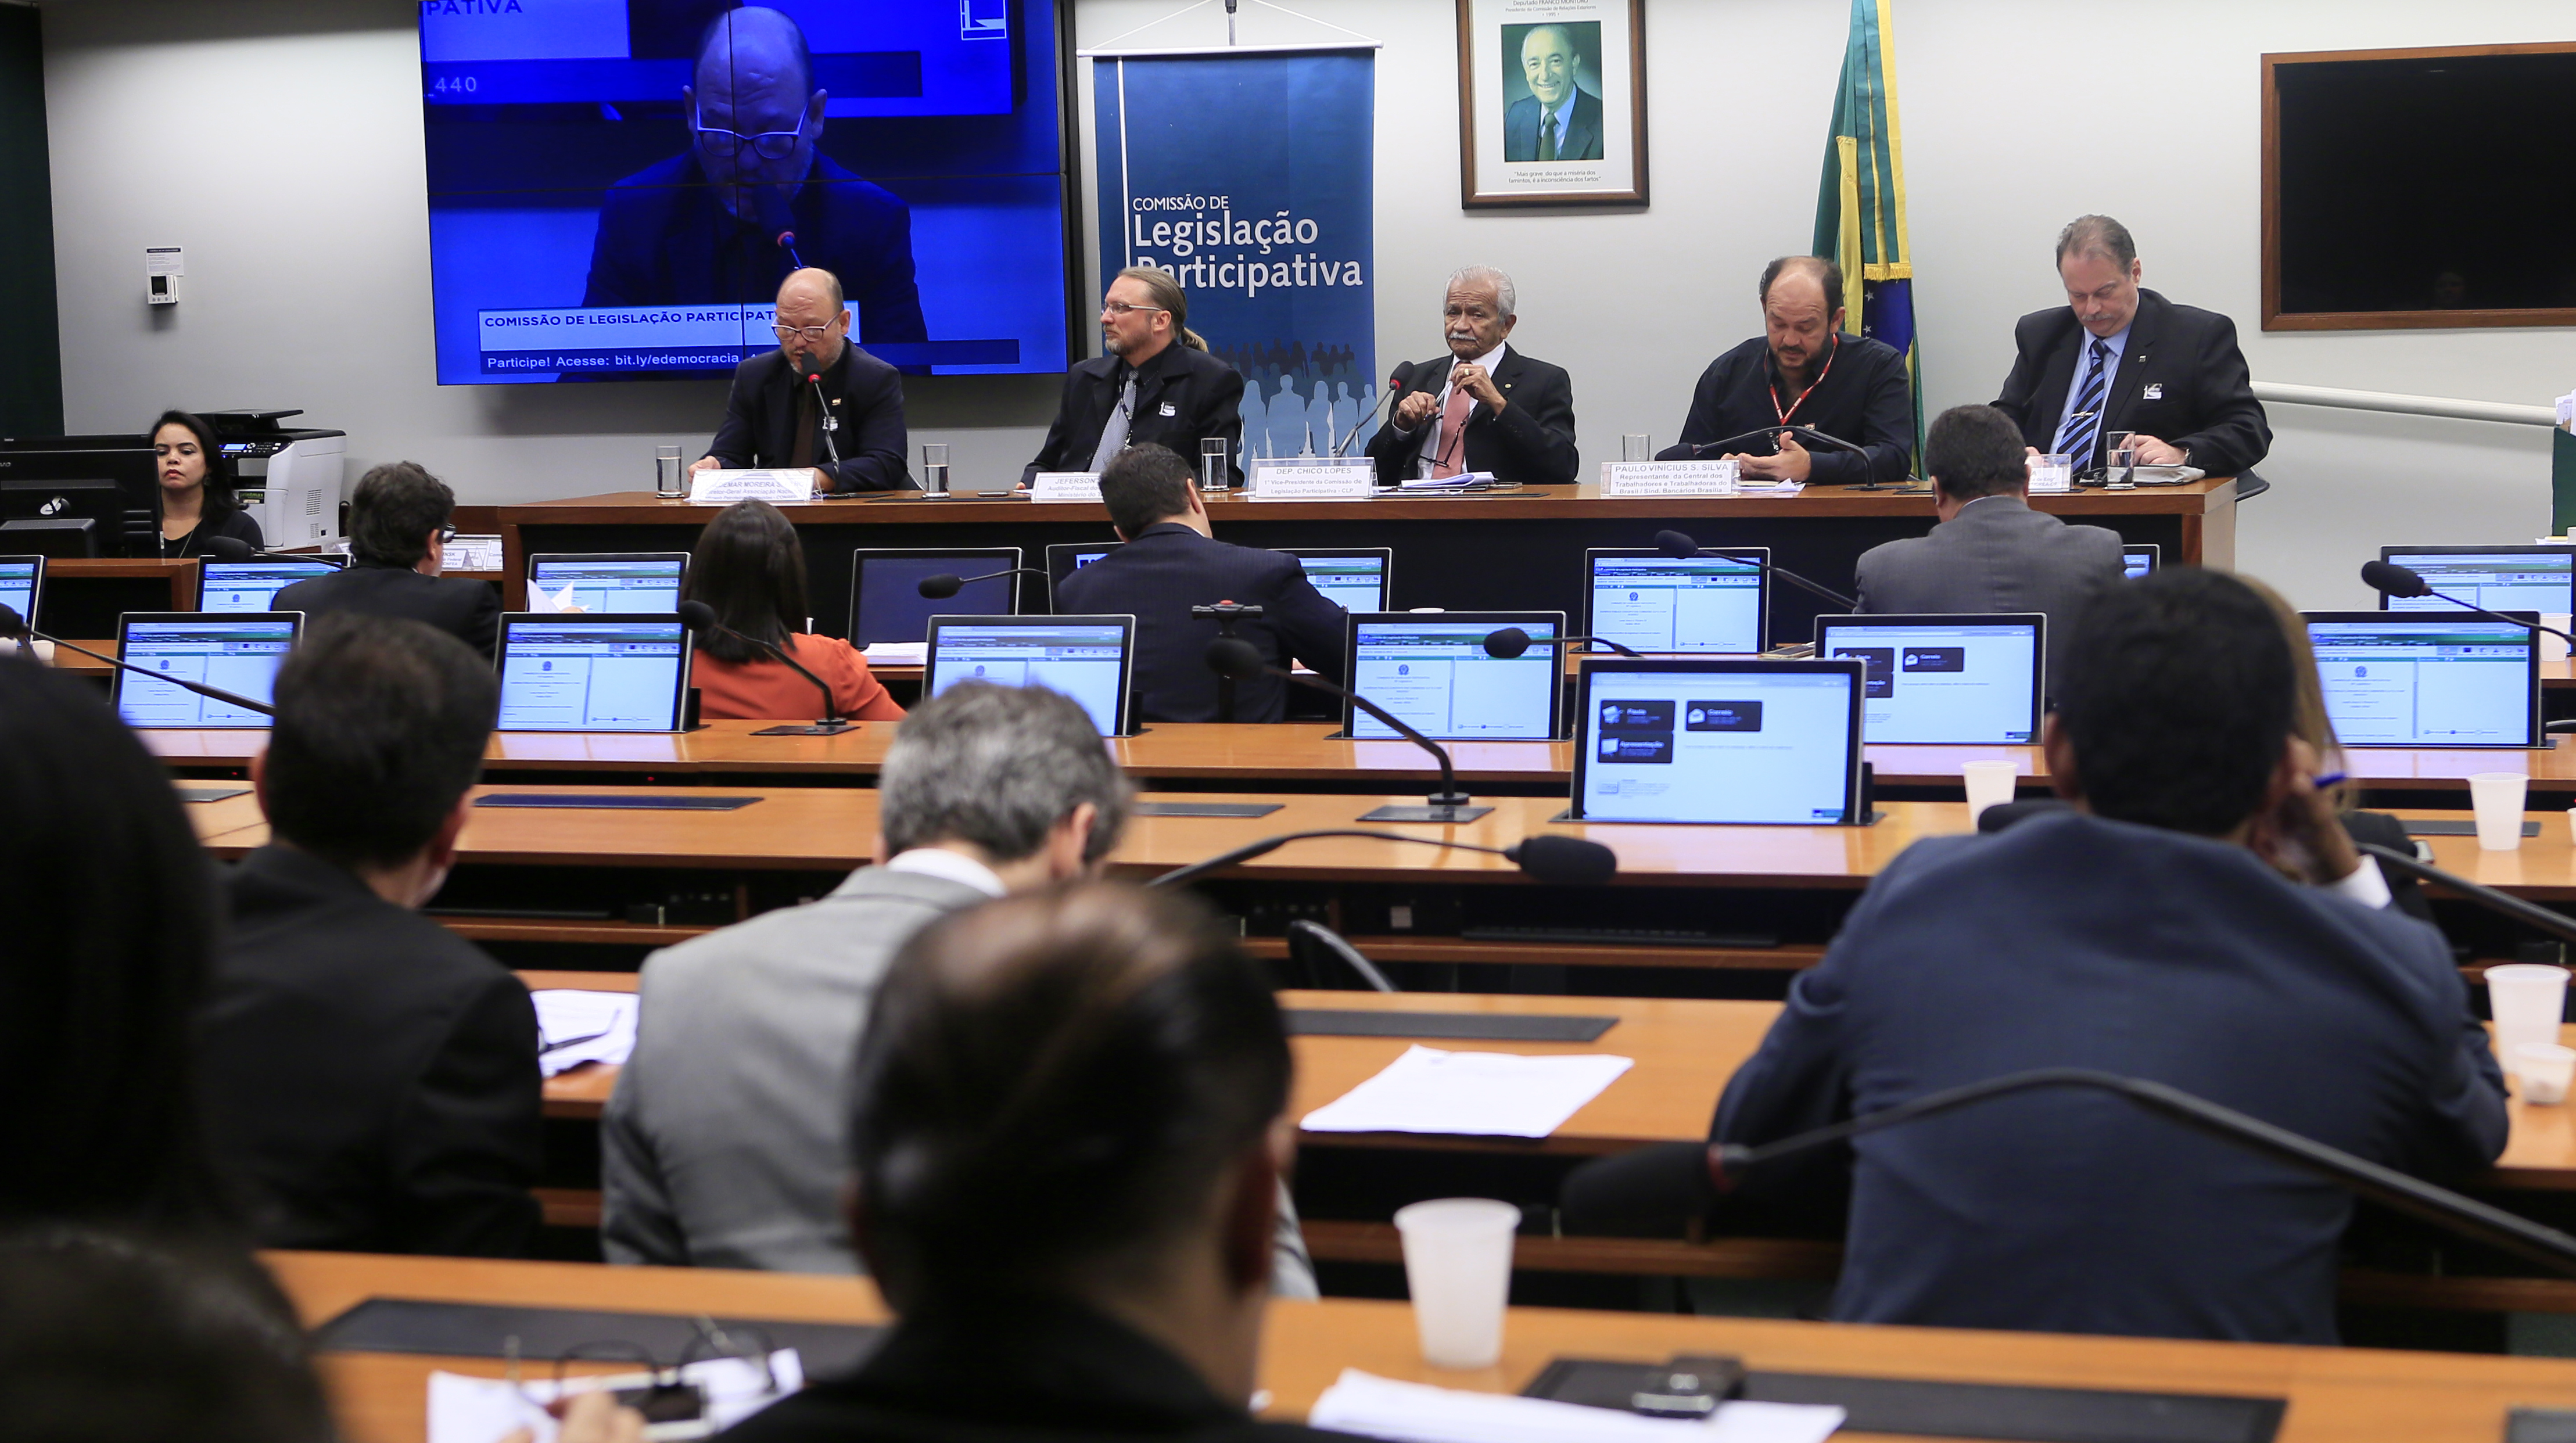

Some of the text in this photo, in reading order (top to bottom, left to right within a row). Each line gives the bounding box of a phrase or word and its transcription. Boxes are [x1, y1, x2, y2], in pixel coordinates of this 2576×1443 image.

[435, 76, 476, 92] 440
[1132, 193, 1229, 211] COMISSÃO DE
[1134, 210, 1319, 257] Legislação
[485, 310, 776, 326] COMISSÃO DE LEGISLAÇÃO PARTICIPAT
[487, 352, 740, 369] Participe! Acesse: bit.ly/edemocracia
[1649, 462, 1687, 472] VINÍCIUS
